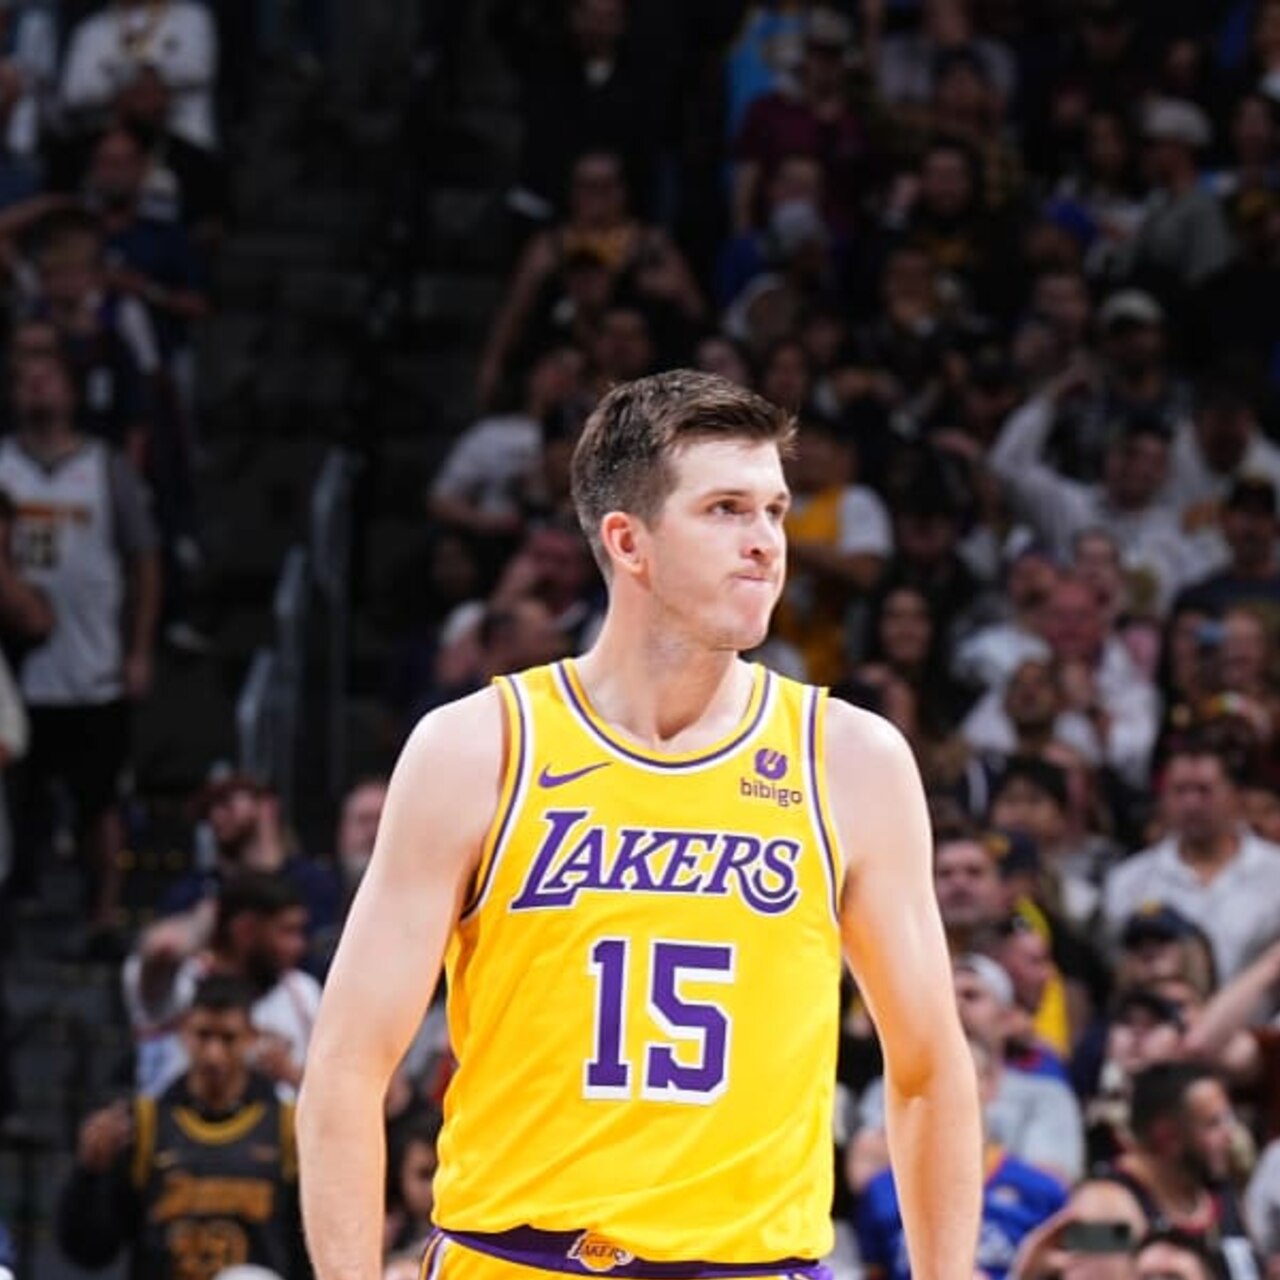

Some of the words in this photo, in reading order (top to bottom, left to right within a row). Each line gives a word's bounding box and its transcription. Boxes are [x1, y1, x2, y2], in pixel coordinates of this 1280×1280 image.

[740, 778, 803, 808] bibigo
[509, 809, 803, 915] LAKERS
[582, 936, 736, 1105] 15
